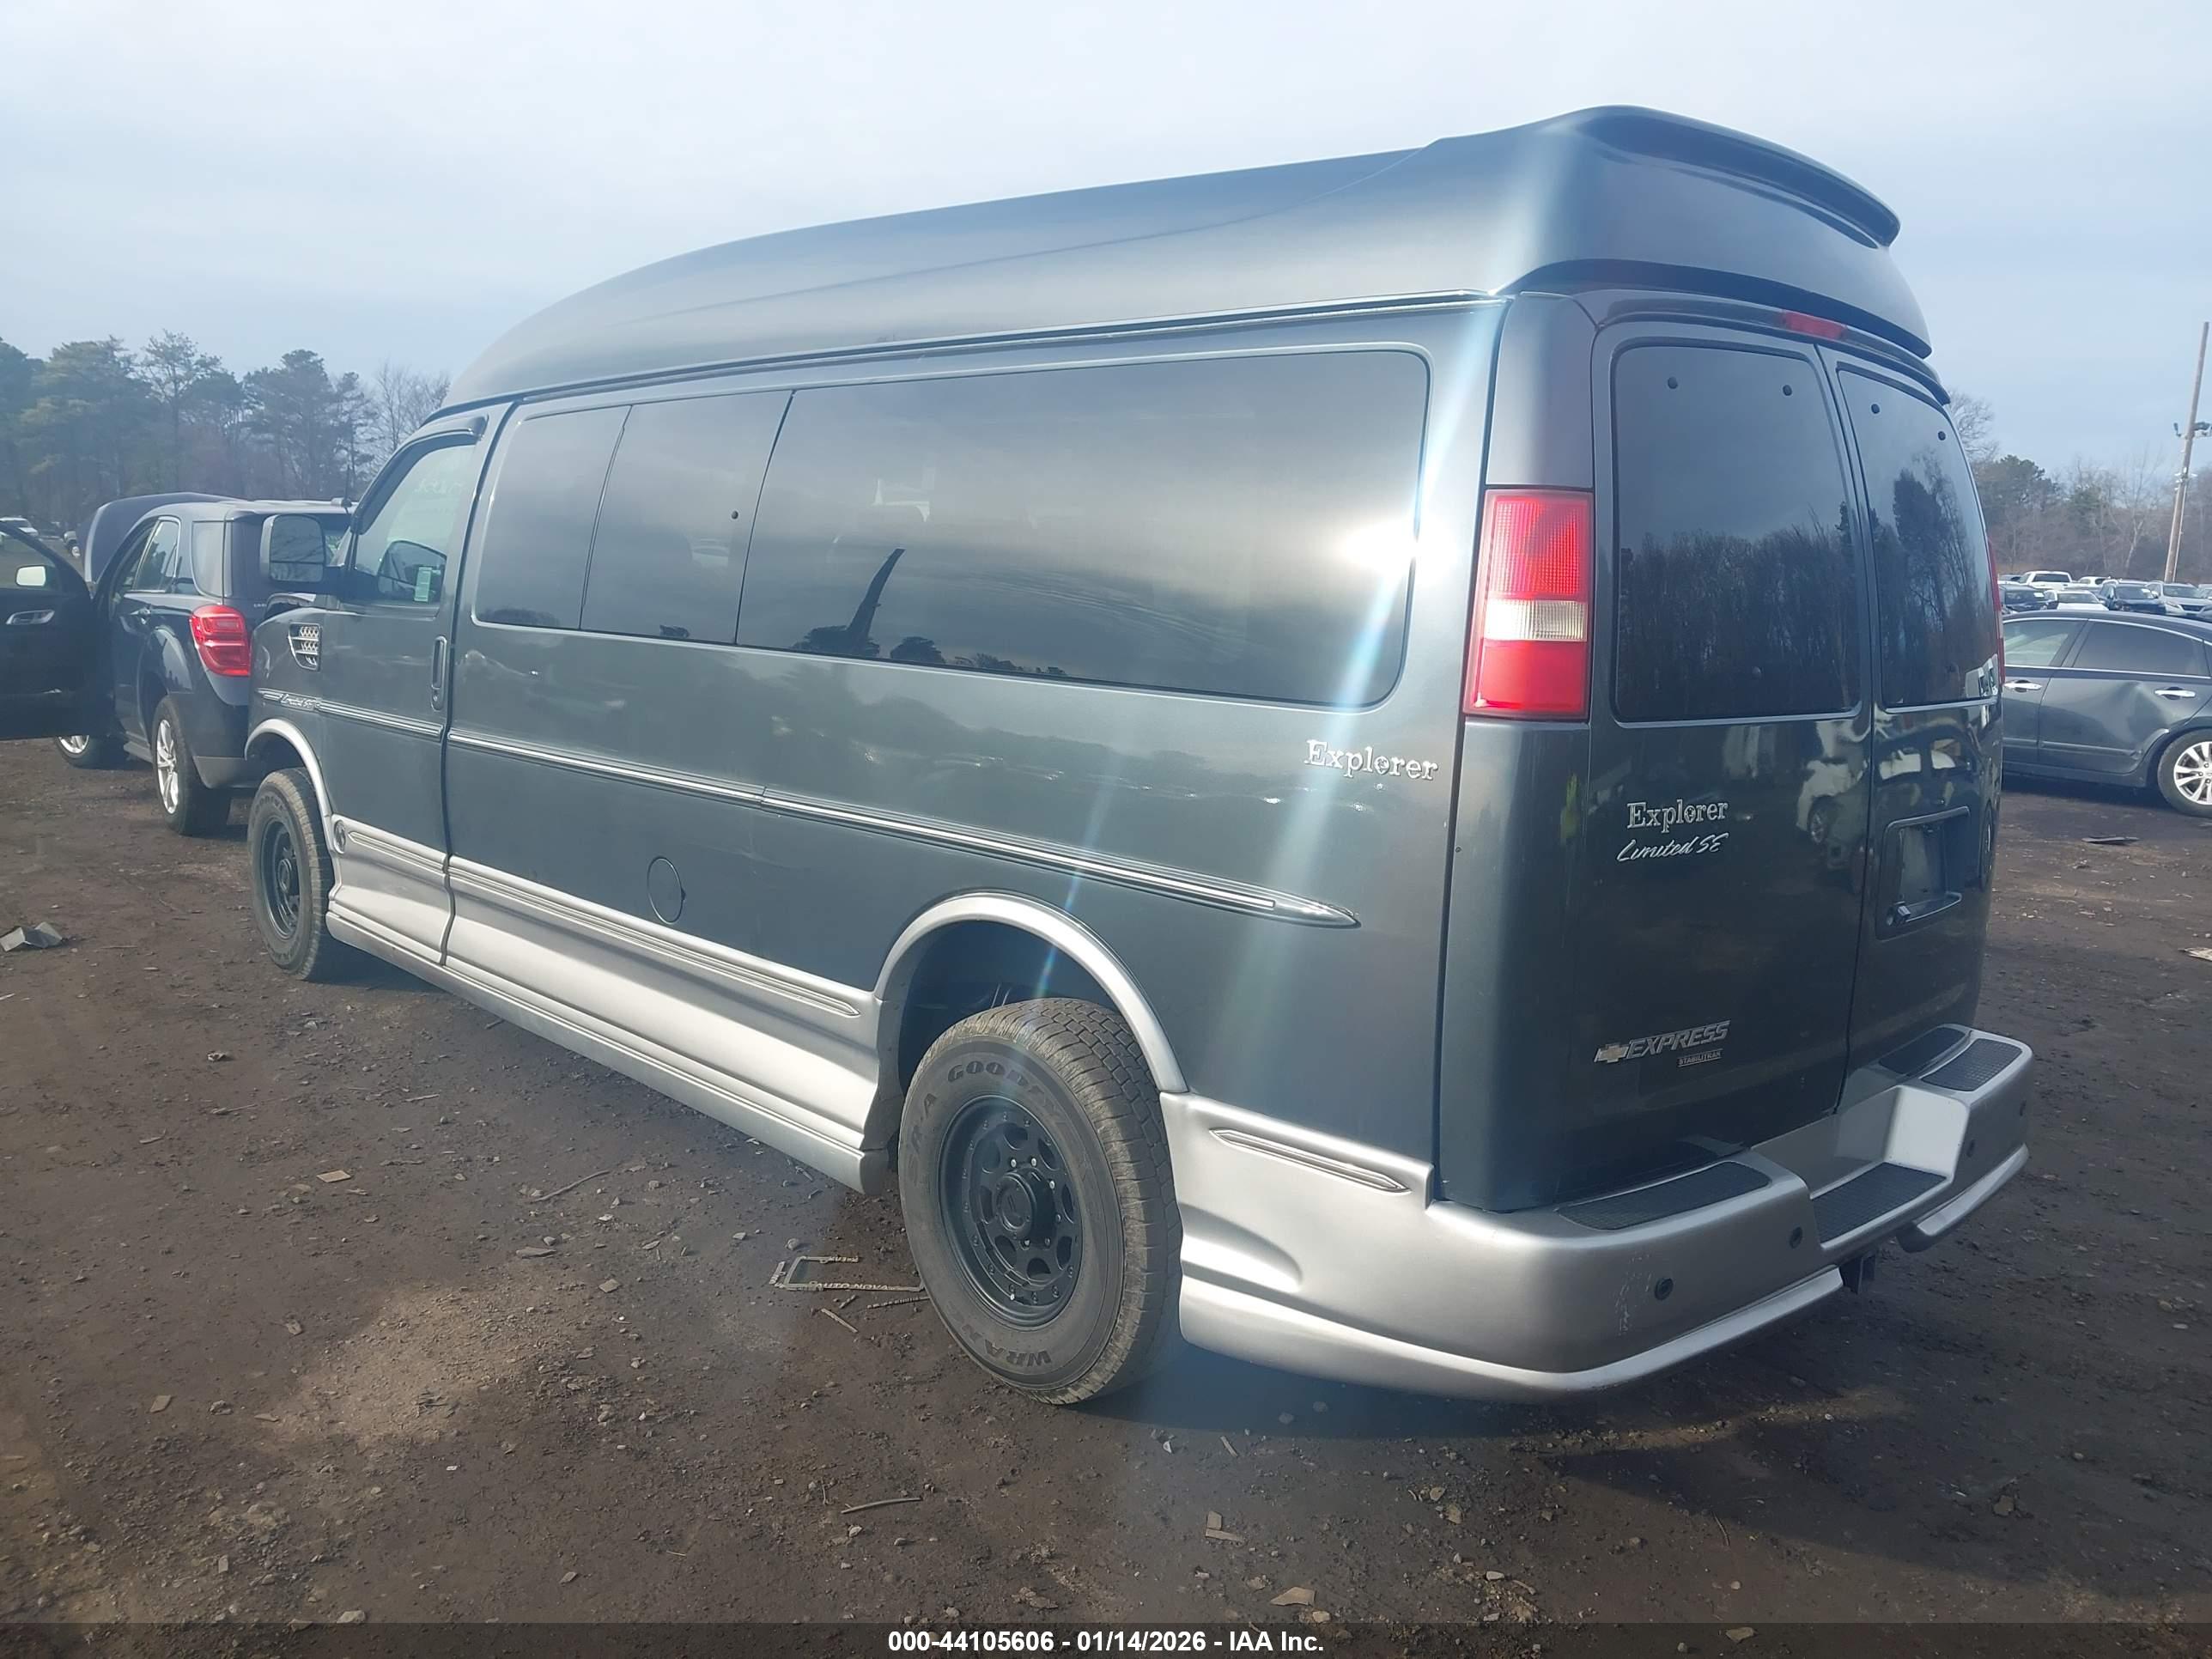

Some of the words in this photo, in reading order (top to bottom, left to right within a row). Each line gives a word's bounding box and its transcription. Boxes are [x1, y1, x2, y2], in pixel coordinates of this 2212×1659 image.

[1304, 739, 1438, 780] Explorer
[1627, 799, 1729, 833] Explorer
[1616, 836, 1700, 862] Limited
[1696, 832, 1729, 853] SE
[1625, 1020, 1731, 1060] EXPRESS
